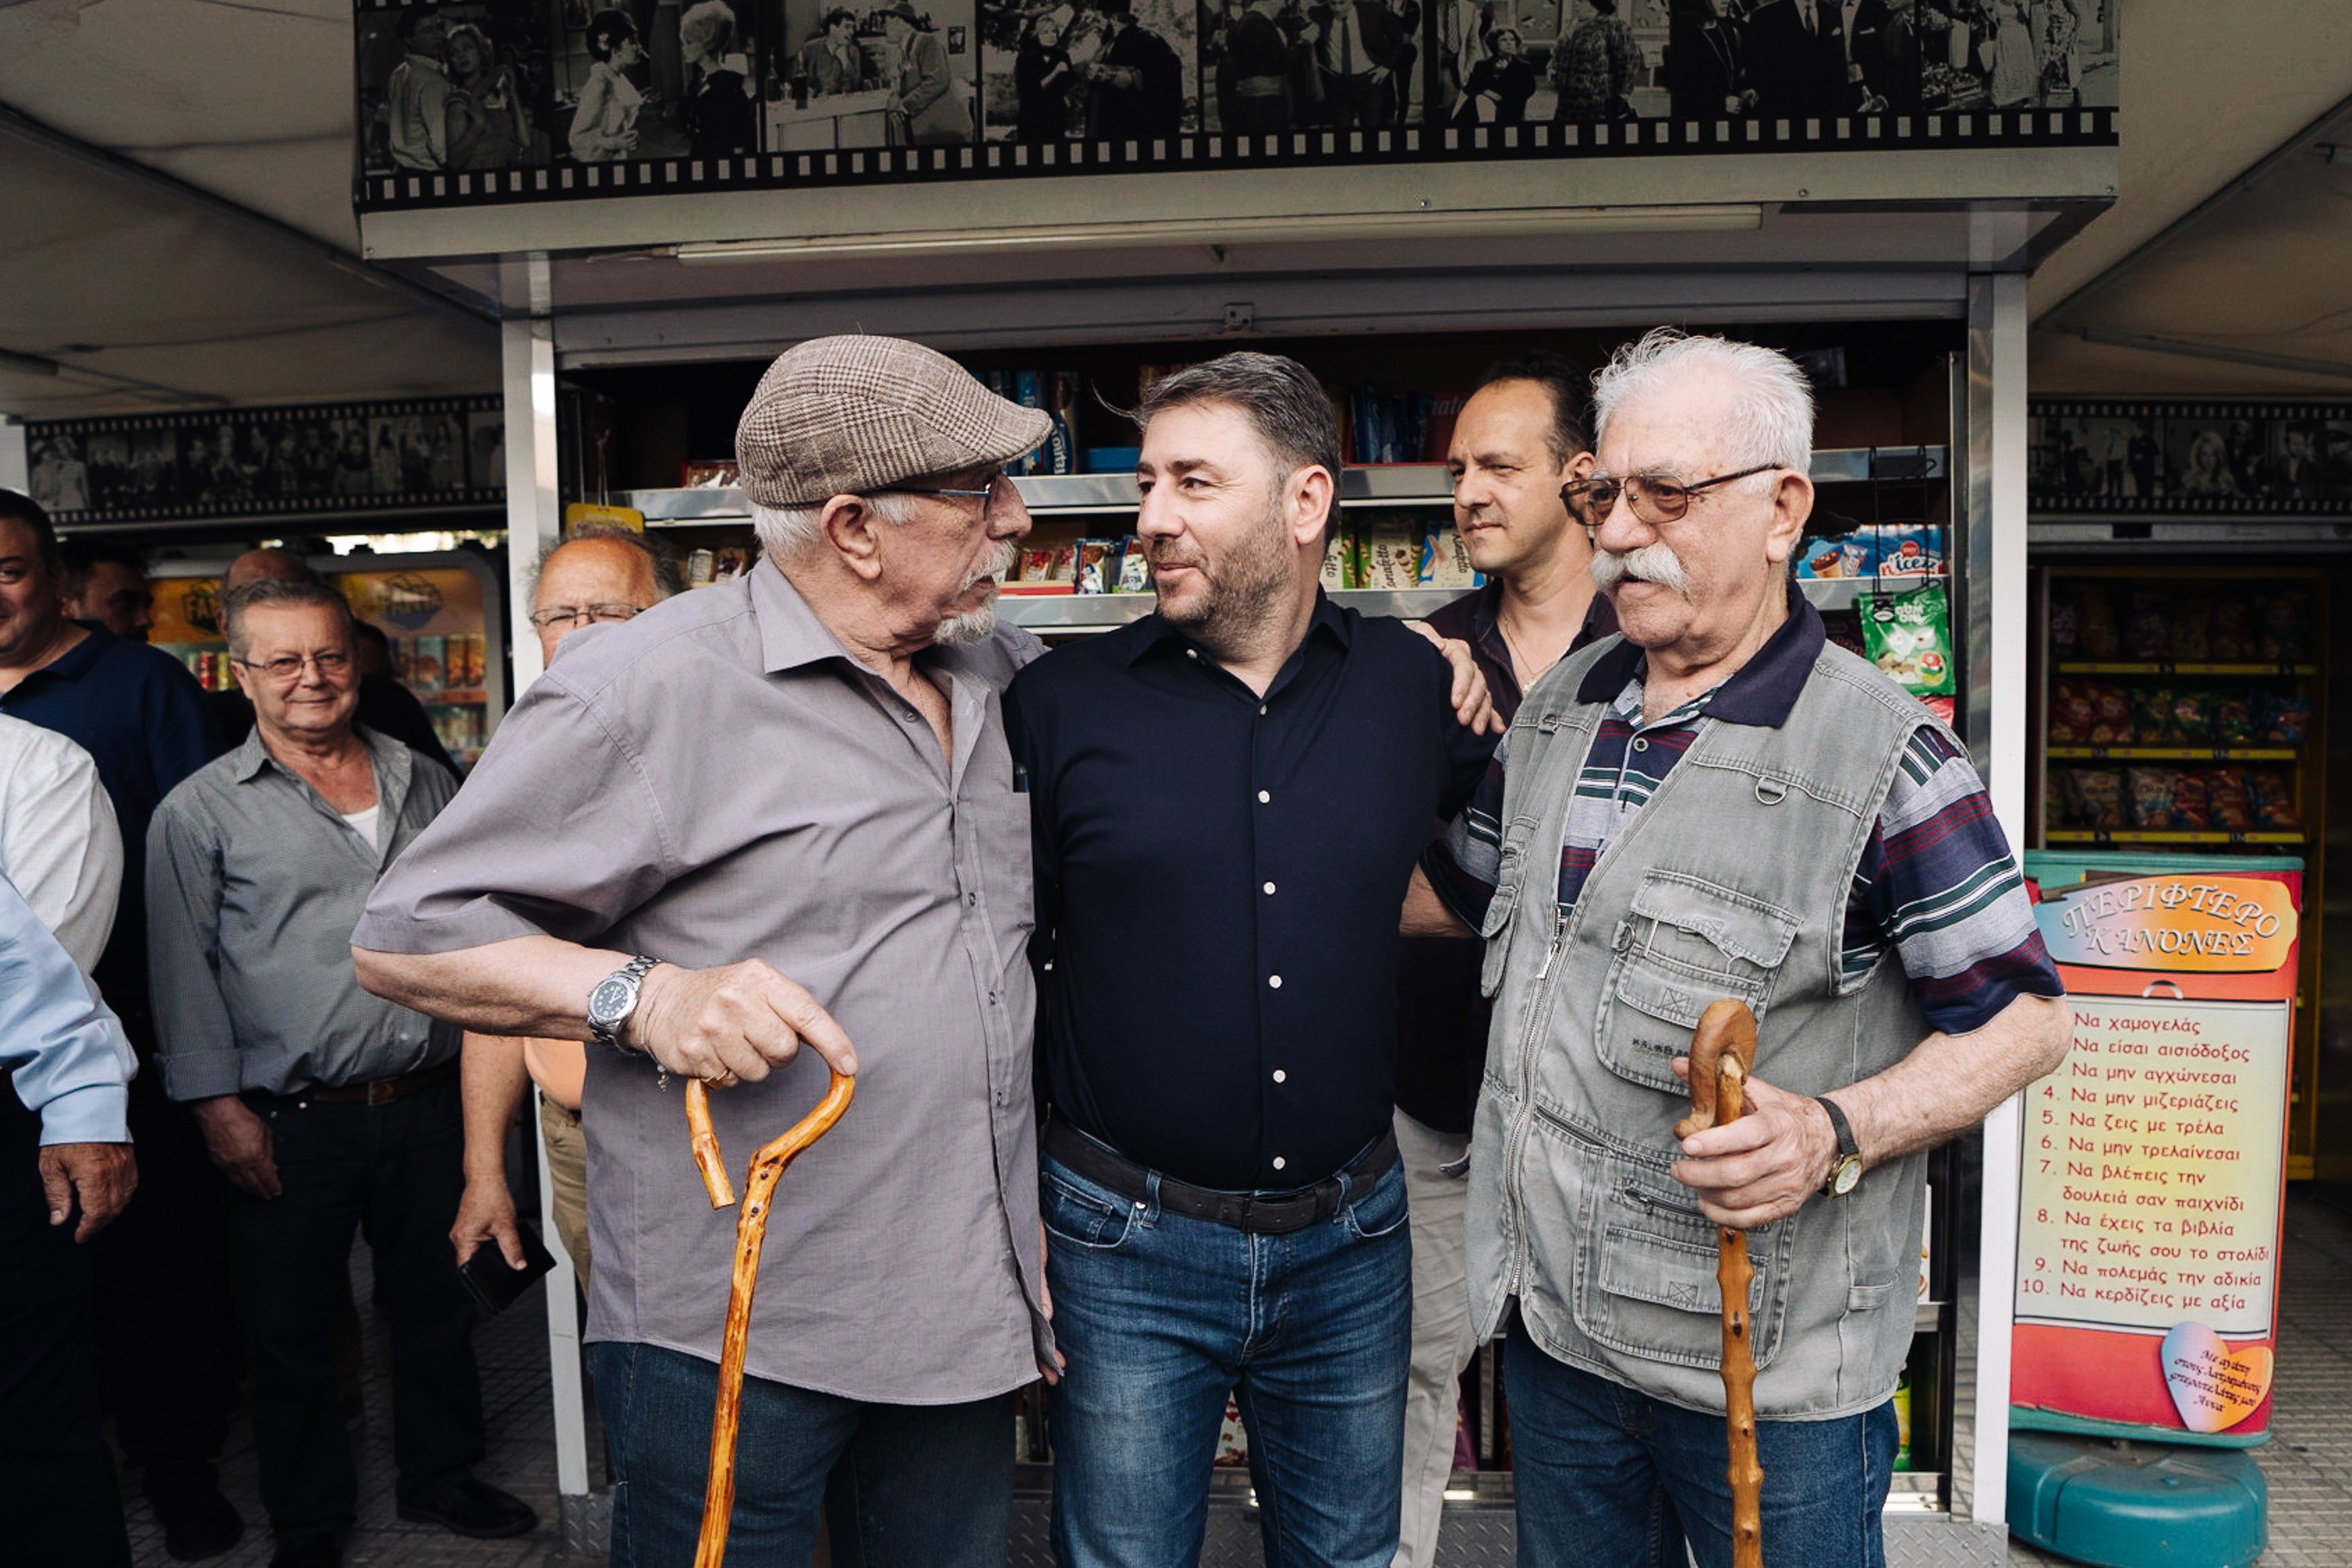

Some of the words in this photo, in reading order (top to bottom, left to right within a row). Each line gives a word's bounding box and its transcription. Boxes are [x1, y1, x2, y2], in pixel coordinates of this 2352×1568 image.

[2062, 883, 2281, 939] ΠΕΡΙΦΤΕΡΟ
[2074, 1013, 2100, 1027] Να
[2109, 1018, 2201, 1035] χαμογελάς
[2073, 1038, 2099, 1052] Να
[2108, 1041, 2148, 1054] είσαι
[2157, 1043, 2249, 1062] αισιόδοξος
[2072, 1062, 2097, 1077] Να
[2106, 1069, 2135, 1080] μην
[2144, 1070, 2237, 1084] αγχώνεσαι
[2071, 1088, 2096, 1102] Να
[2105, 1094, 2134, 1106] μην
[2143, 1092, 2237, 1113] μιζεριάζεις
[2069, 1112, 2095, 1127] Να
[2103, 1114, 2138, 1133] ζεις
[2146, 1121, 2166, 1133] με
[2177, 1119, 2224, 1136] τρέλα
[2068, 1137, 2095, 1151] Να
[2103, 1142, 2132, 1156] μην
[2142, 1144, 2240, 1161] τρελαίνεσαι
[2067, 1162, 2093, 1177] Να
[2101, 1164, 2167, 1185] βλέπεις
[2178, 1172, 2205, 1184] την
[2063, 1185, 2127, 1205] δουλειά
[2135, 1195, 2166, 1207] σαν
[2175, 1196, 2244, 1212] παιχνίδι
[2065, 1211, 2091, 1226] Να
[2099, 1217, 2144, 1233] έχεις
[2154, 1221, 2173, 1233] τα
[2181, 1219, 2234, 1237] βιβλία
[2062, 1239, 2087, 1253] της
[2097, 1237, 2140, 1258] ζωής
[2150, 1246, 2182, 1258] σου
[2190, 1248, 2208, 1260] το
[2216, 1246, 2269, 1262] στολίδι
[2062, 1260, 2088, 1274] Να
[2097, 1266, 2167, 1284] πολεμάς
[2179, 1273, 2205, 1285] την
[2214, 1272, 2261, 1285] αδικία
[2060, 1282, 2086, 1297] Να
[2095, 1287, 2173, 1308] κερδίζεις
[2182, 1297, 2201, 1308] με
[2210, 1295, 2246, 1311] αξία
